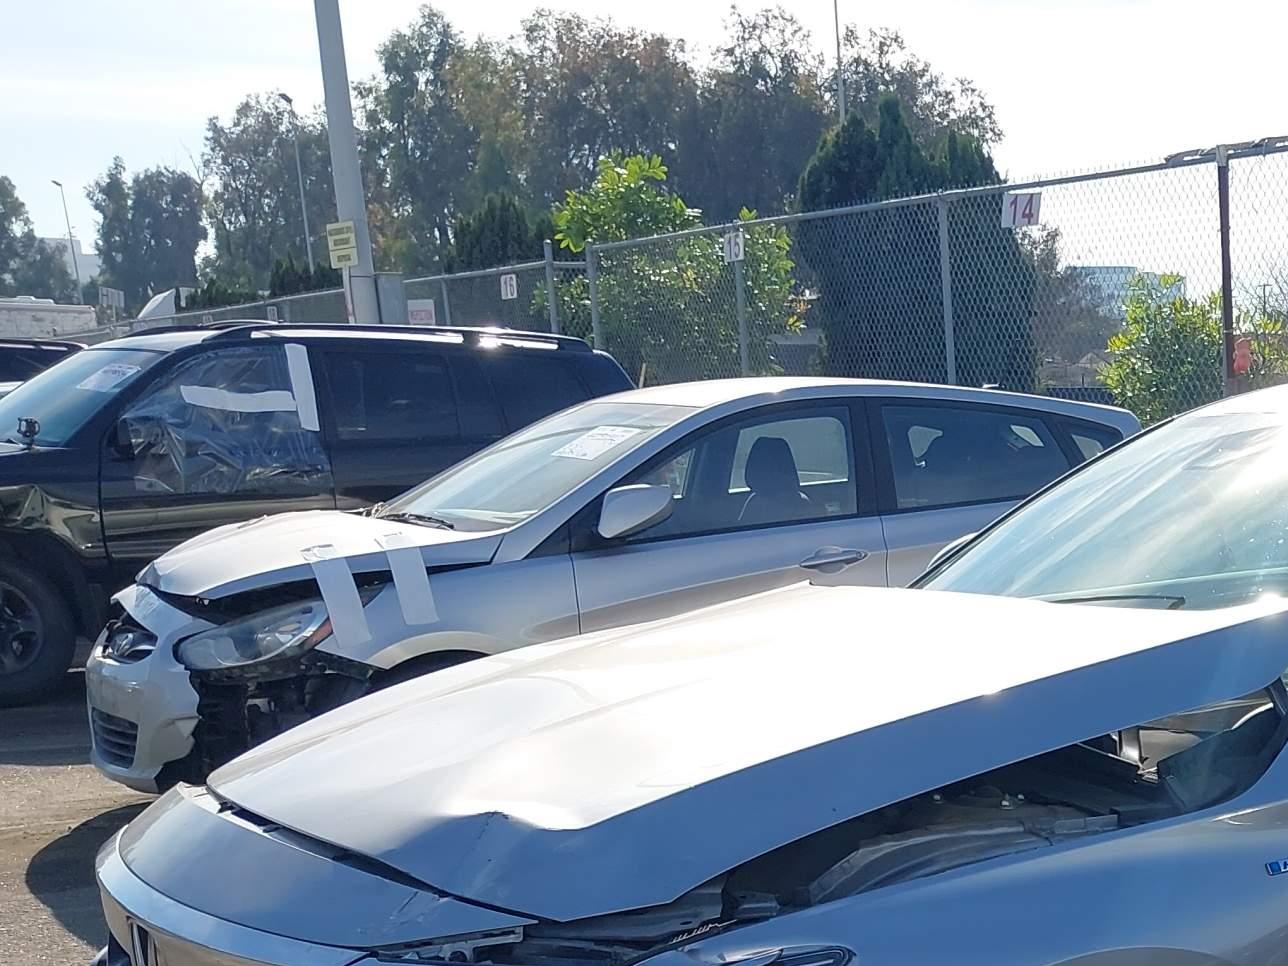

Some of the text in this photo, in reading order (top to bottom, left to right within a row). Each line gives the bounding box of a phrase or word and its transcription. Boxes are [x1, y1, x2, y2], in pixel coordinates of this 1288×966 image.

[1009, 193, 1034, 226] 14
[728, 233, 741, 259] 15
[503, 275, 515, 297] 16
